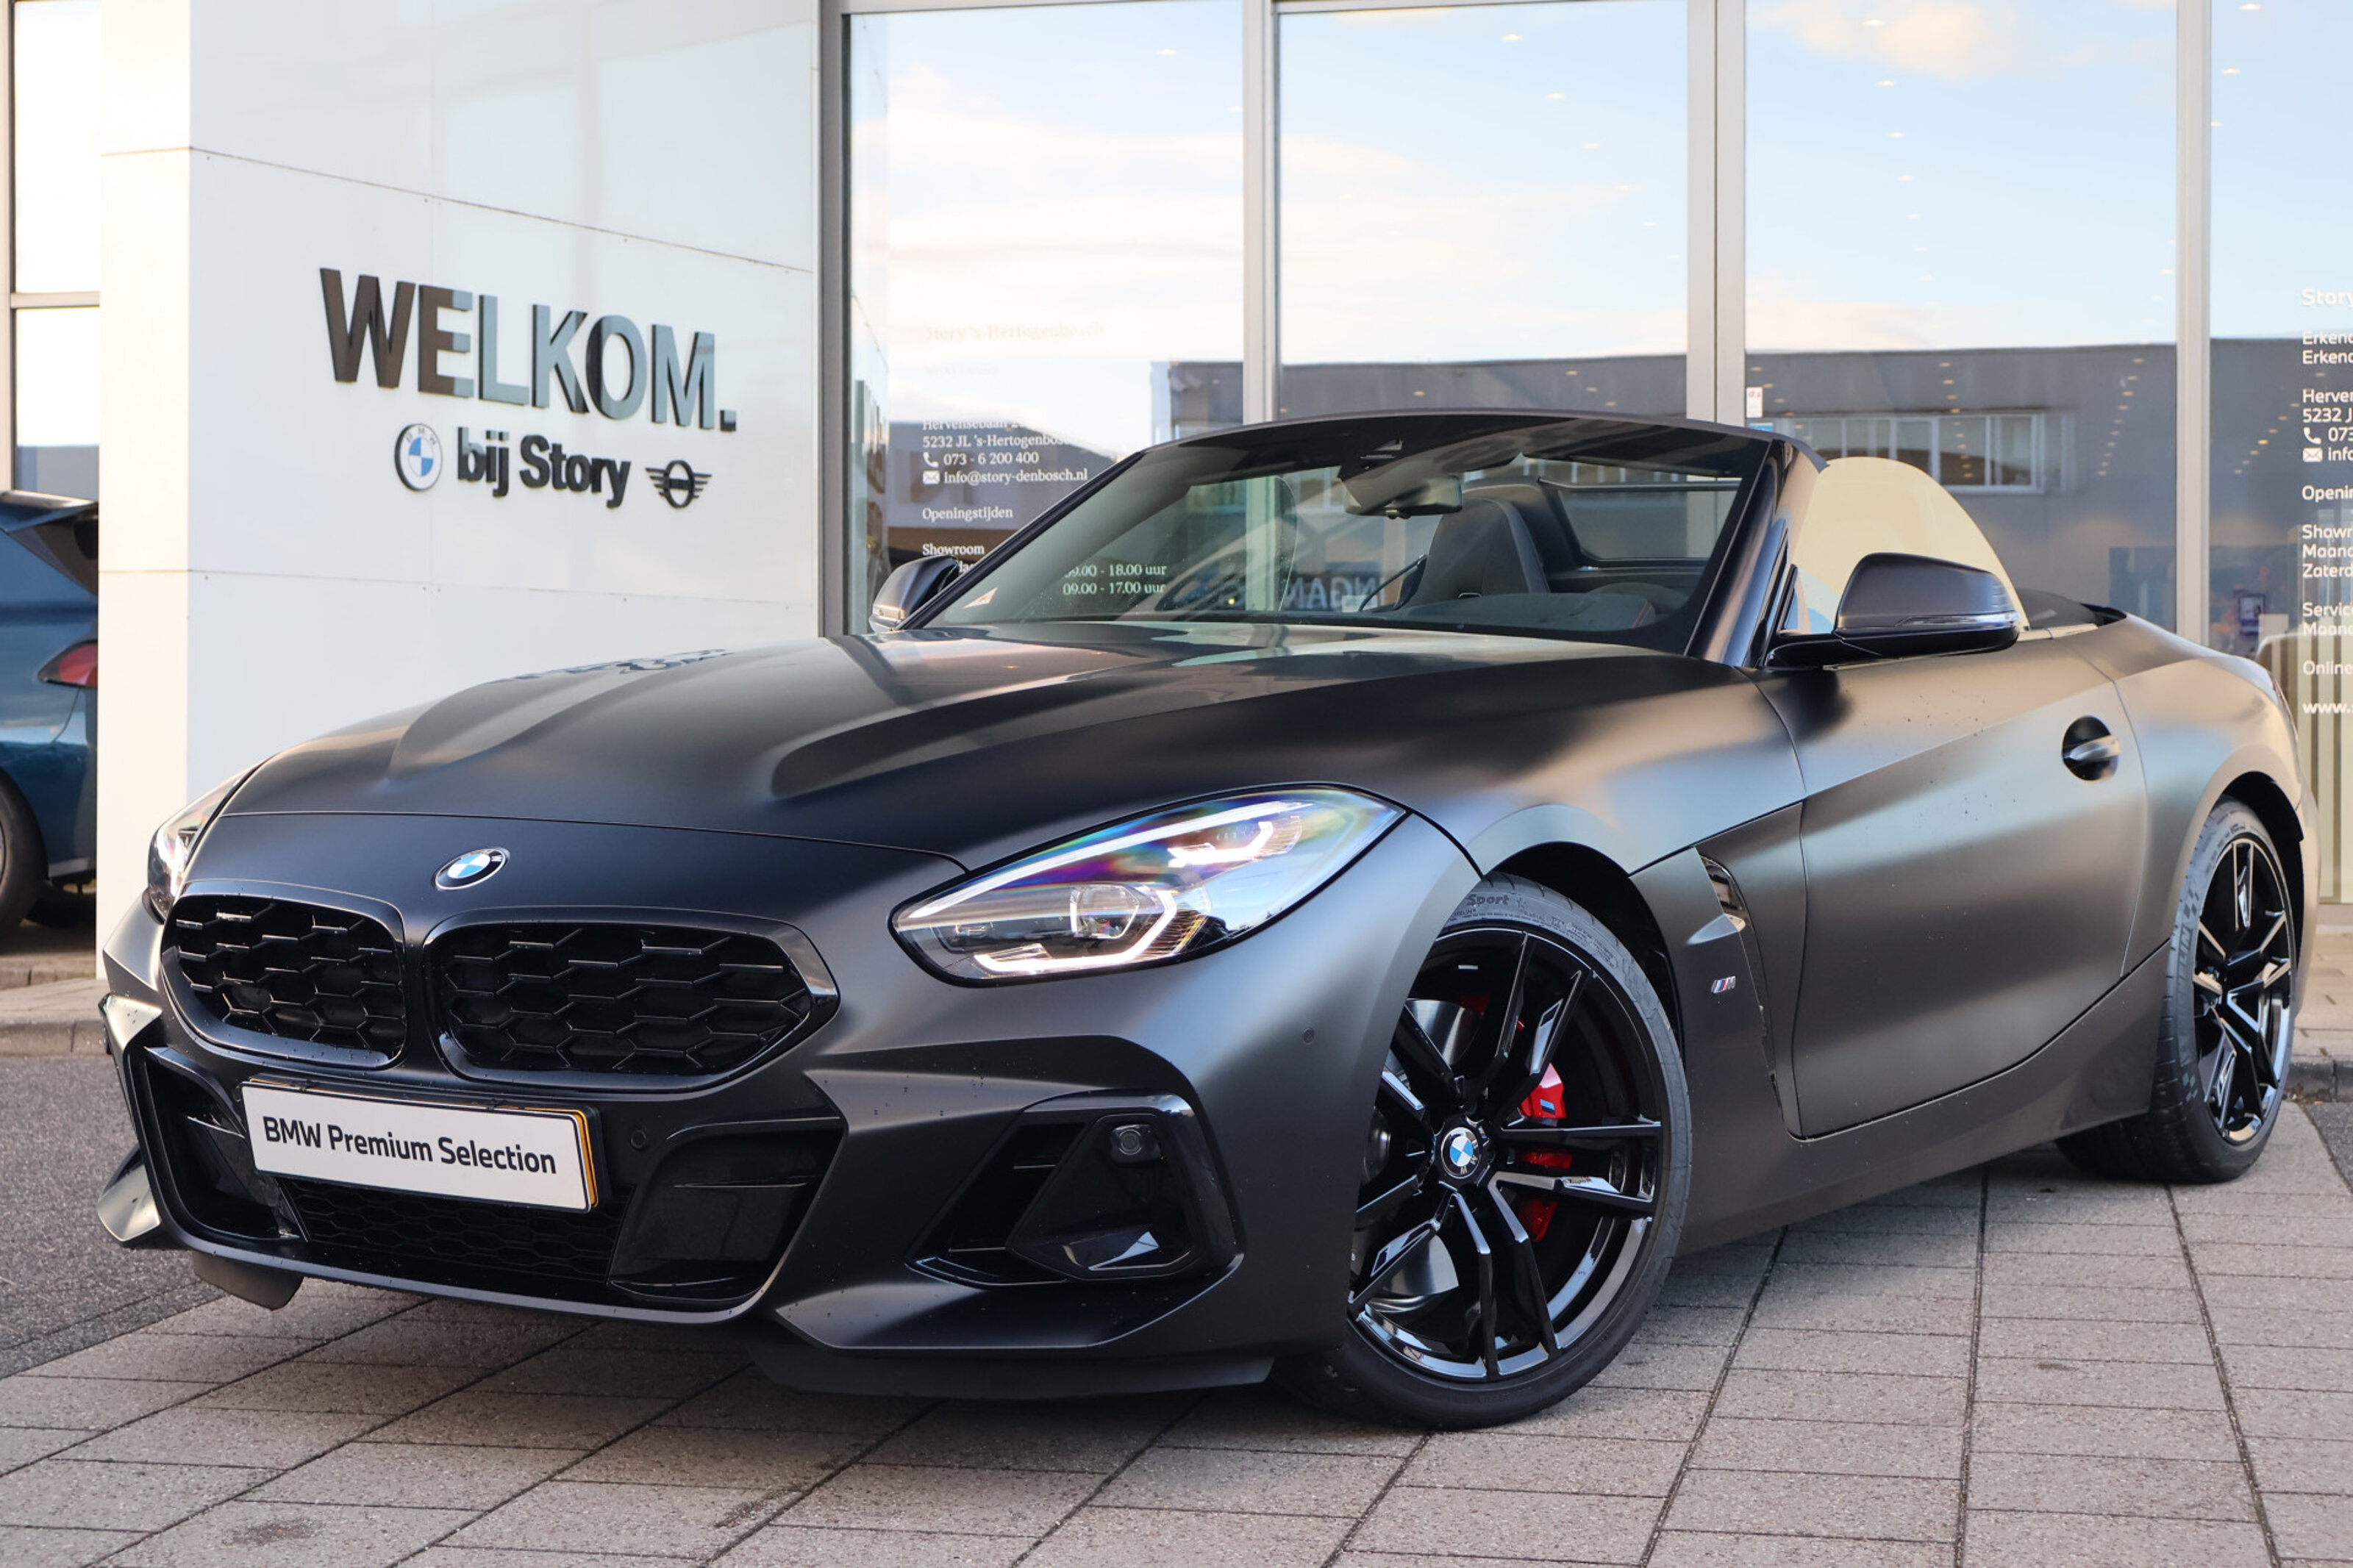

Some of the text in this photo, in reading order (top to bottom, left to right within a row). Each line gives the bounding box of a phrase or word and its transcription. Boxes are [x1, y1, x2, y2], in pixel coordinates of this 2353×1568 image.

[319, 267, 738, 432] WELKOM.
[2302, 407, 2342, 423] 5232
[923, 435, 952, 448] 5232
[956, 435, 971, 448] JL
[943, 453, 968, 466] 073
[978, 453, 986, 465] 6
[989, 452, 1013, 465] 200
[1015, 451, 1039, 465] 400
[457, 426, 632, 509] bij Story
[944, 468, 1088, 486] info@story-denbosch.nl
[922, 506, 1013, 523] Openingstijden
[922, 542, 985, 556] Showroom
[1109, 563, 1143, 577] 18.00
[1145, 565, 1167, 576] uur
[1063, 582, 1097, 595] 09.00
[1109, 581, 1141, 594] 17.00
[1144, 583, 1166, 593] uur
[2302, 602, 2353, 617] Servic
[1466, 893, 1510, 907] Sport
[263, 1115, 557, 1175] BMW Premium Selection
